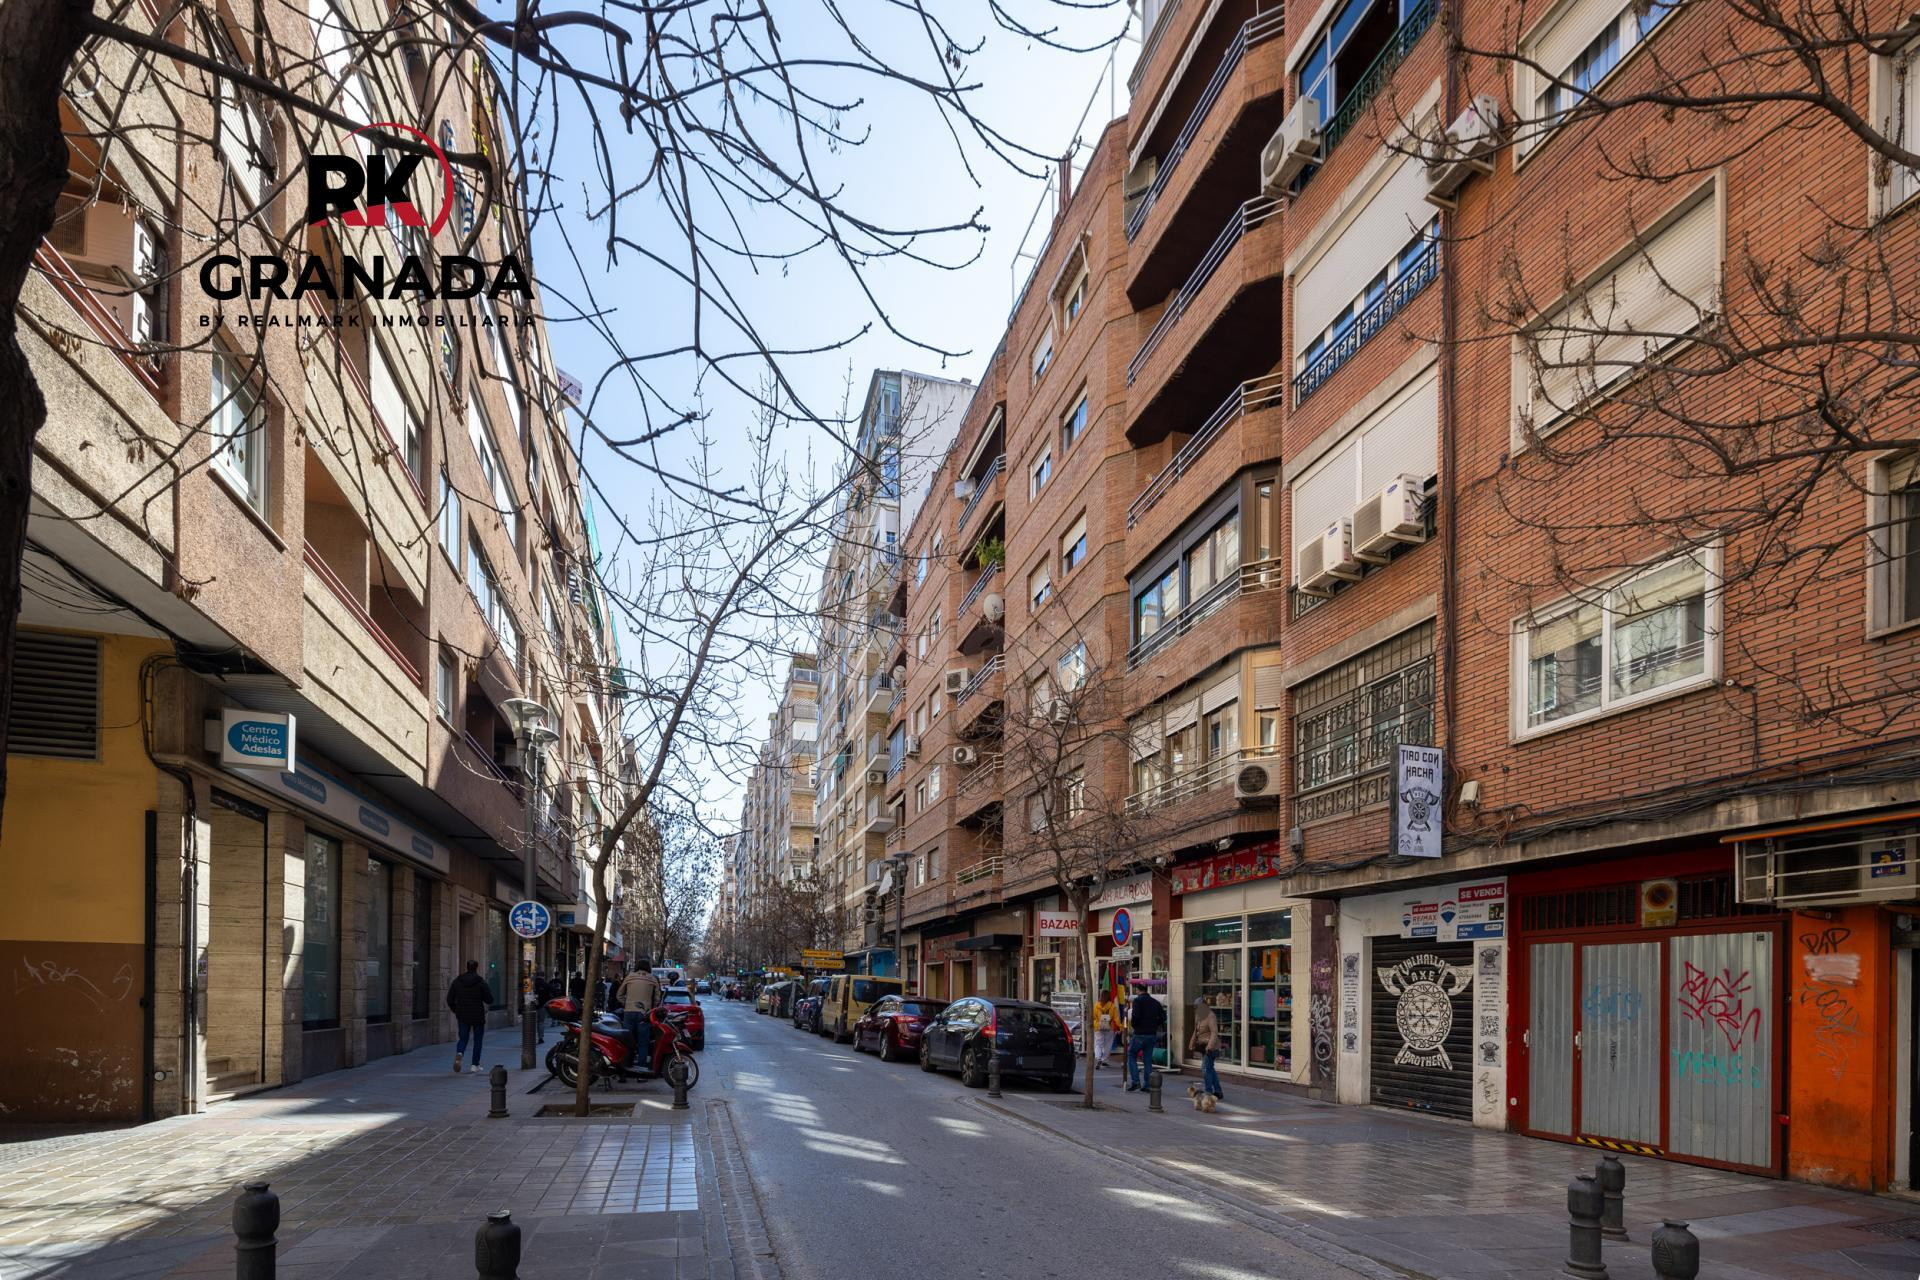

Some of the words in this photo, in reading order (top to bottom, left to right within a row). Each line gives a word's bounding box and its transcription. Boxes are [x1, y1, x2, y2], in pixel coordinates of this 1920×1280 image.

[241, 724, 278, 735] Centro
[241, 733, 281, 745] Médico
[241, 743, 282, 755] Adeslas
[1422, 752, 1440, 769] CON
[1405, 765, 1434, 784] HACHA
[1460, 890, 1472, 899] SE
[1473, 886, 1503, 898] VENDE
[1040, 918, 1078, 930] BAZAR
[1400, 953, 1446, 976] VALHALLA
[1411, 970, 1436, 982] AXE
[1400, 1051, 1447, 1070] BROTHER
